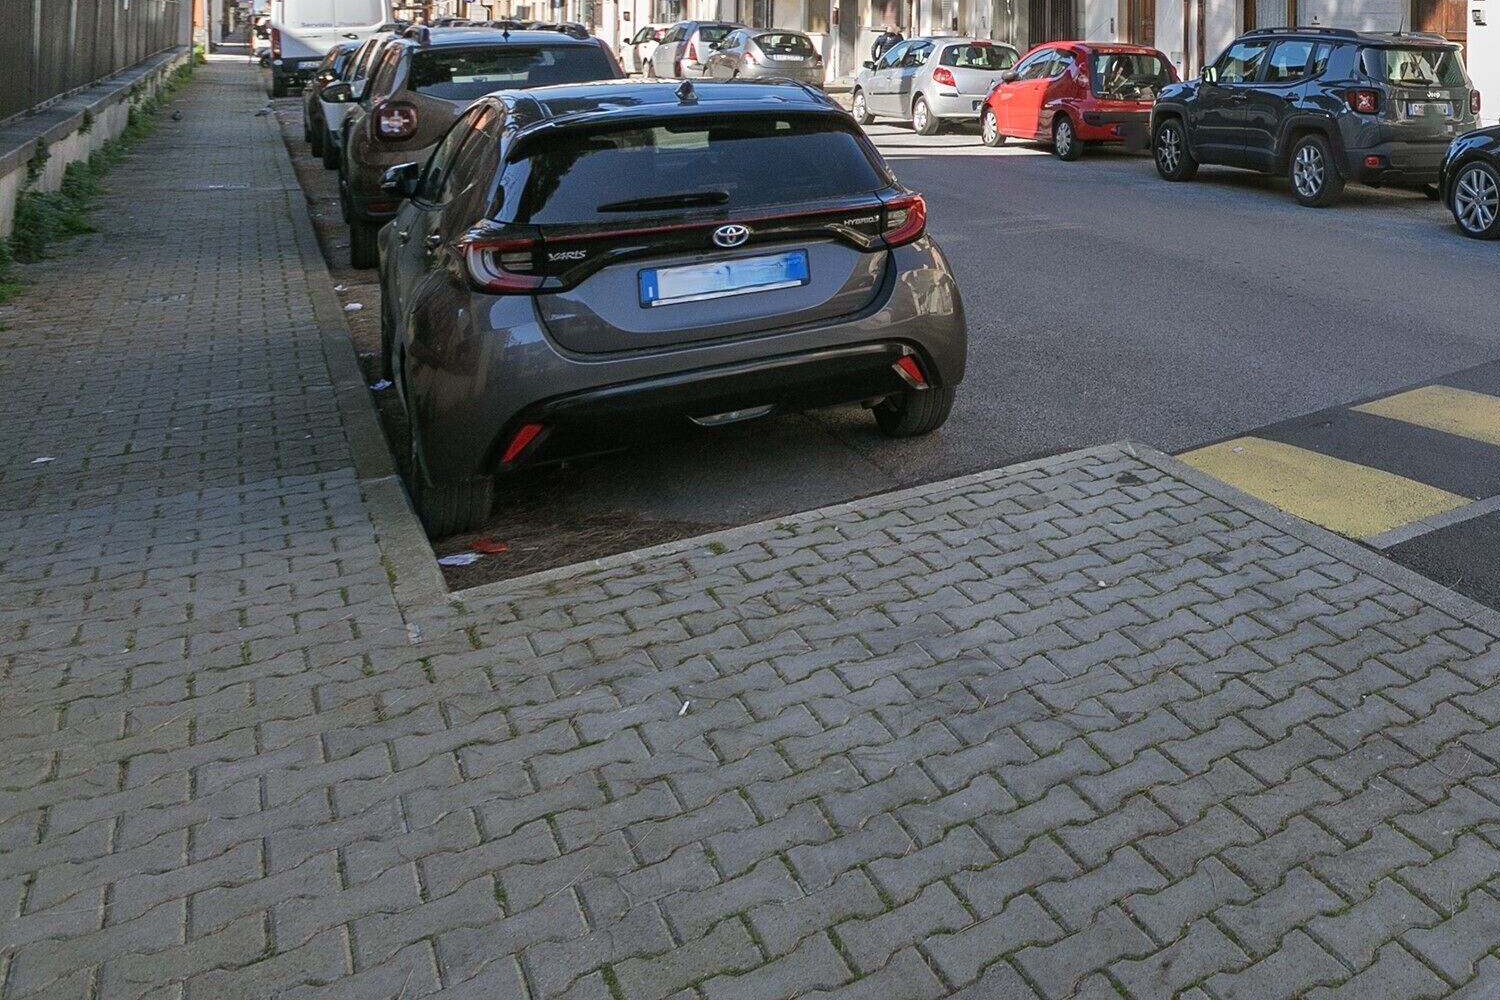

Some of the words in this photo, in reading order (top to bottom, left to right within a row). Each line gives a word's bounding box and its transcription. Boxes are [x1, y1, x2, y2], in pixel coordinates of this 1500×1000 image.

[1427, 91, 1441, 99] Jeep
[843, 216, 874, 226] HYBRID
[548, 250, 587, 261] YARIS
